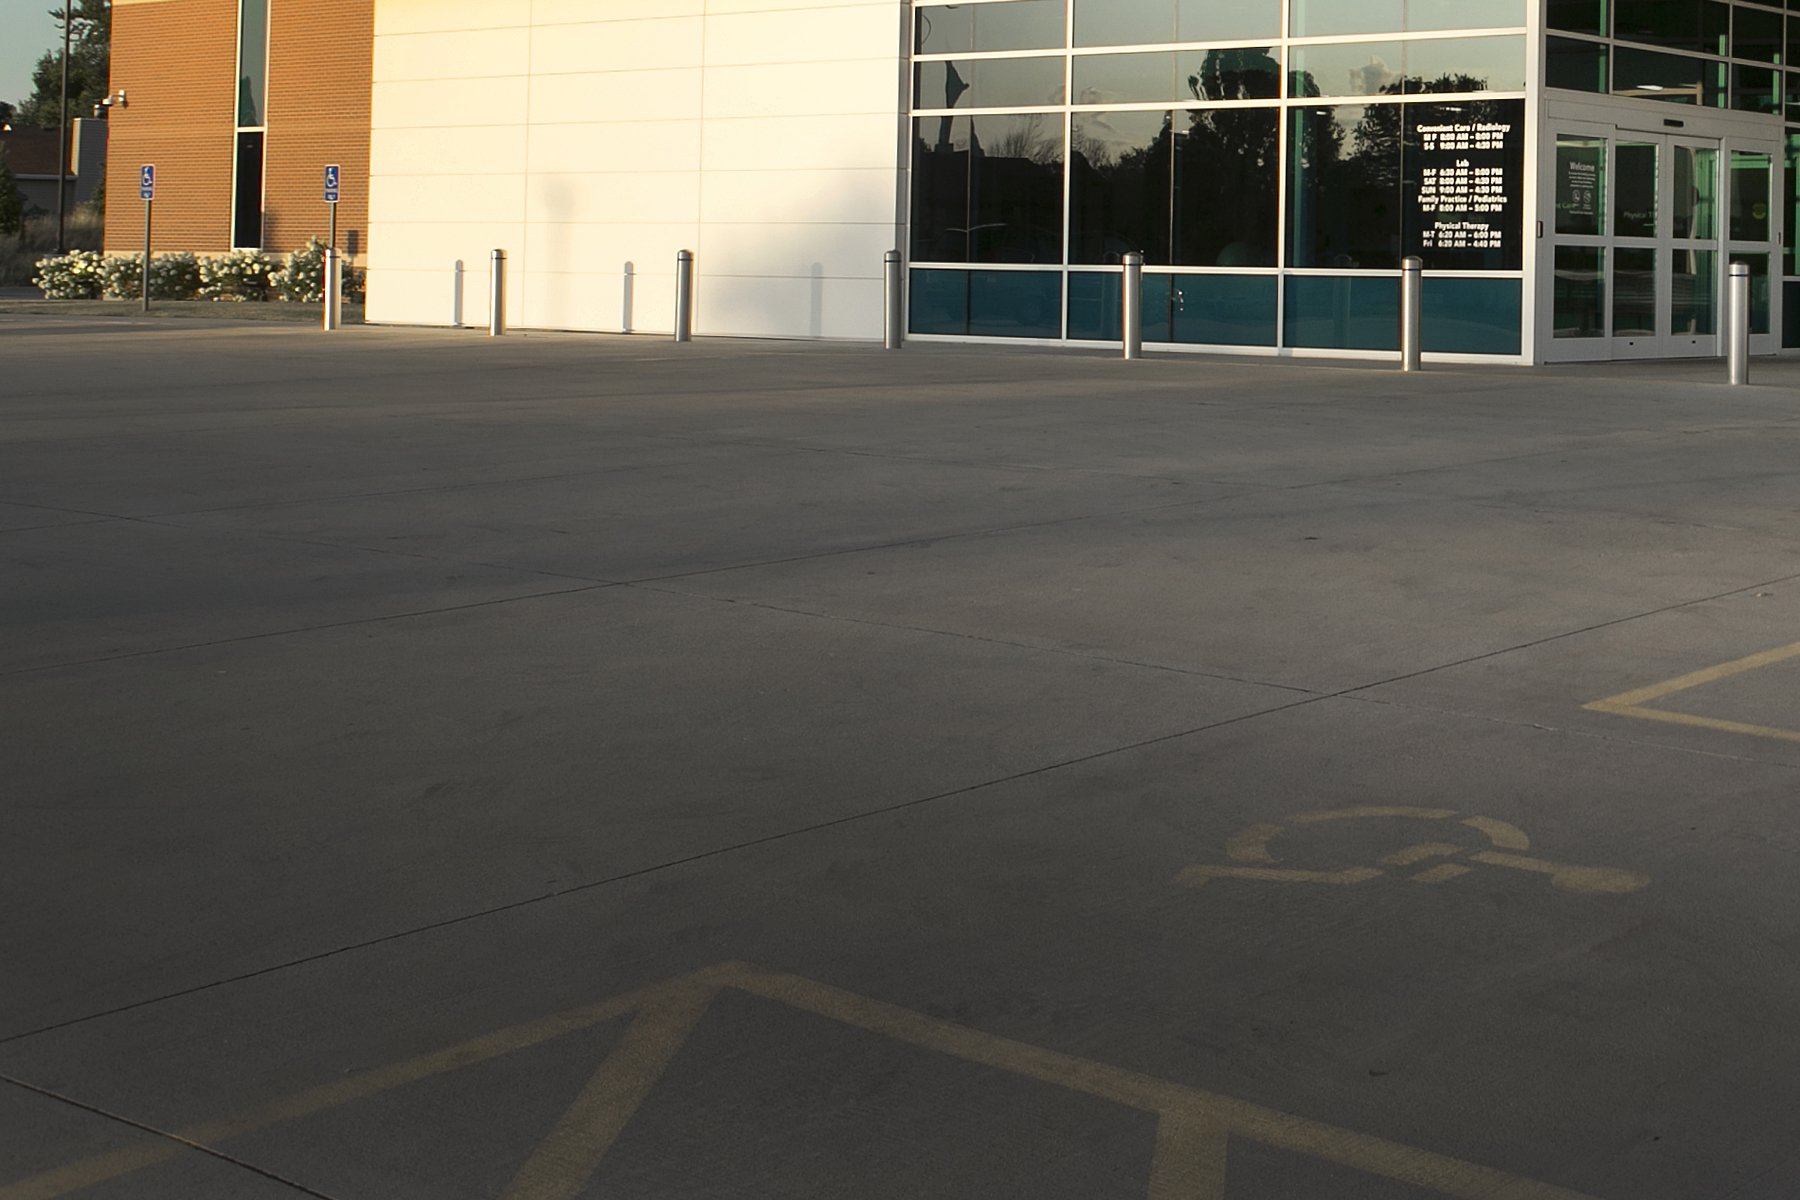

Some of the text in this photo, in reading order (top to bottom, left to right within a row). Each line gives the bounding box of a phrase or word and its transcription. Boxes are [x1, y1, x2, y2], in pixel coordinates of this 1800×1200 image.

[1416, 124, 1454, 133] Convenient
[1454, 123, 1470, 132] Care
[1476, 122, 1511, 133] Radiology
[1492, 132, 1503, 140] PM
[1492, 141, 1503, 149] PM
[1456, 159, 1469, 167] Lab
[1569, 161, 1595, 172] Welcome
[1454, 168, 1468, 176] AM
[1491, 167, 1503, 176] PM
[1424, 177, 1436, 185] SAT
[1491, 176, 1503, 184] PM
[1421, 186, 1436, 194] SUN
[1491, 185, 1503, 193] PM
[1418, 195, 1439, 204] Family
[1440, 195, 1467, 203] Practice
[1474, 195, 1508, 203] Pediatrics
[1491, 203, 1502, 211] PM
[1435, 221, 1489, 231] Physical Therapy
[1490, 230, 1501, 238] PM
[1423, 240, 1432, 248] Fri
[1490, 239, 1501, 247] PM
